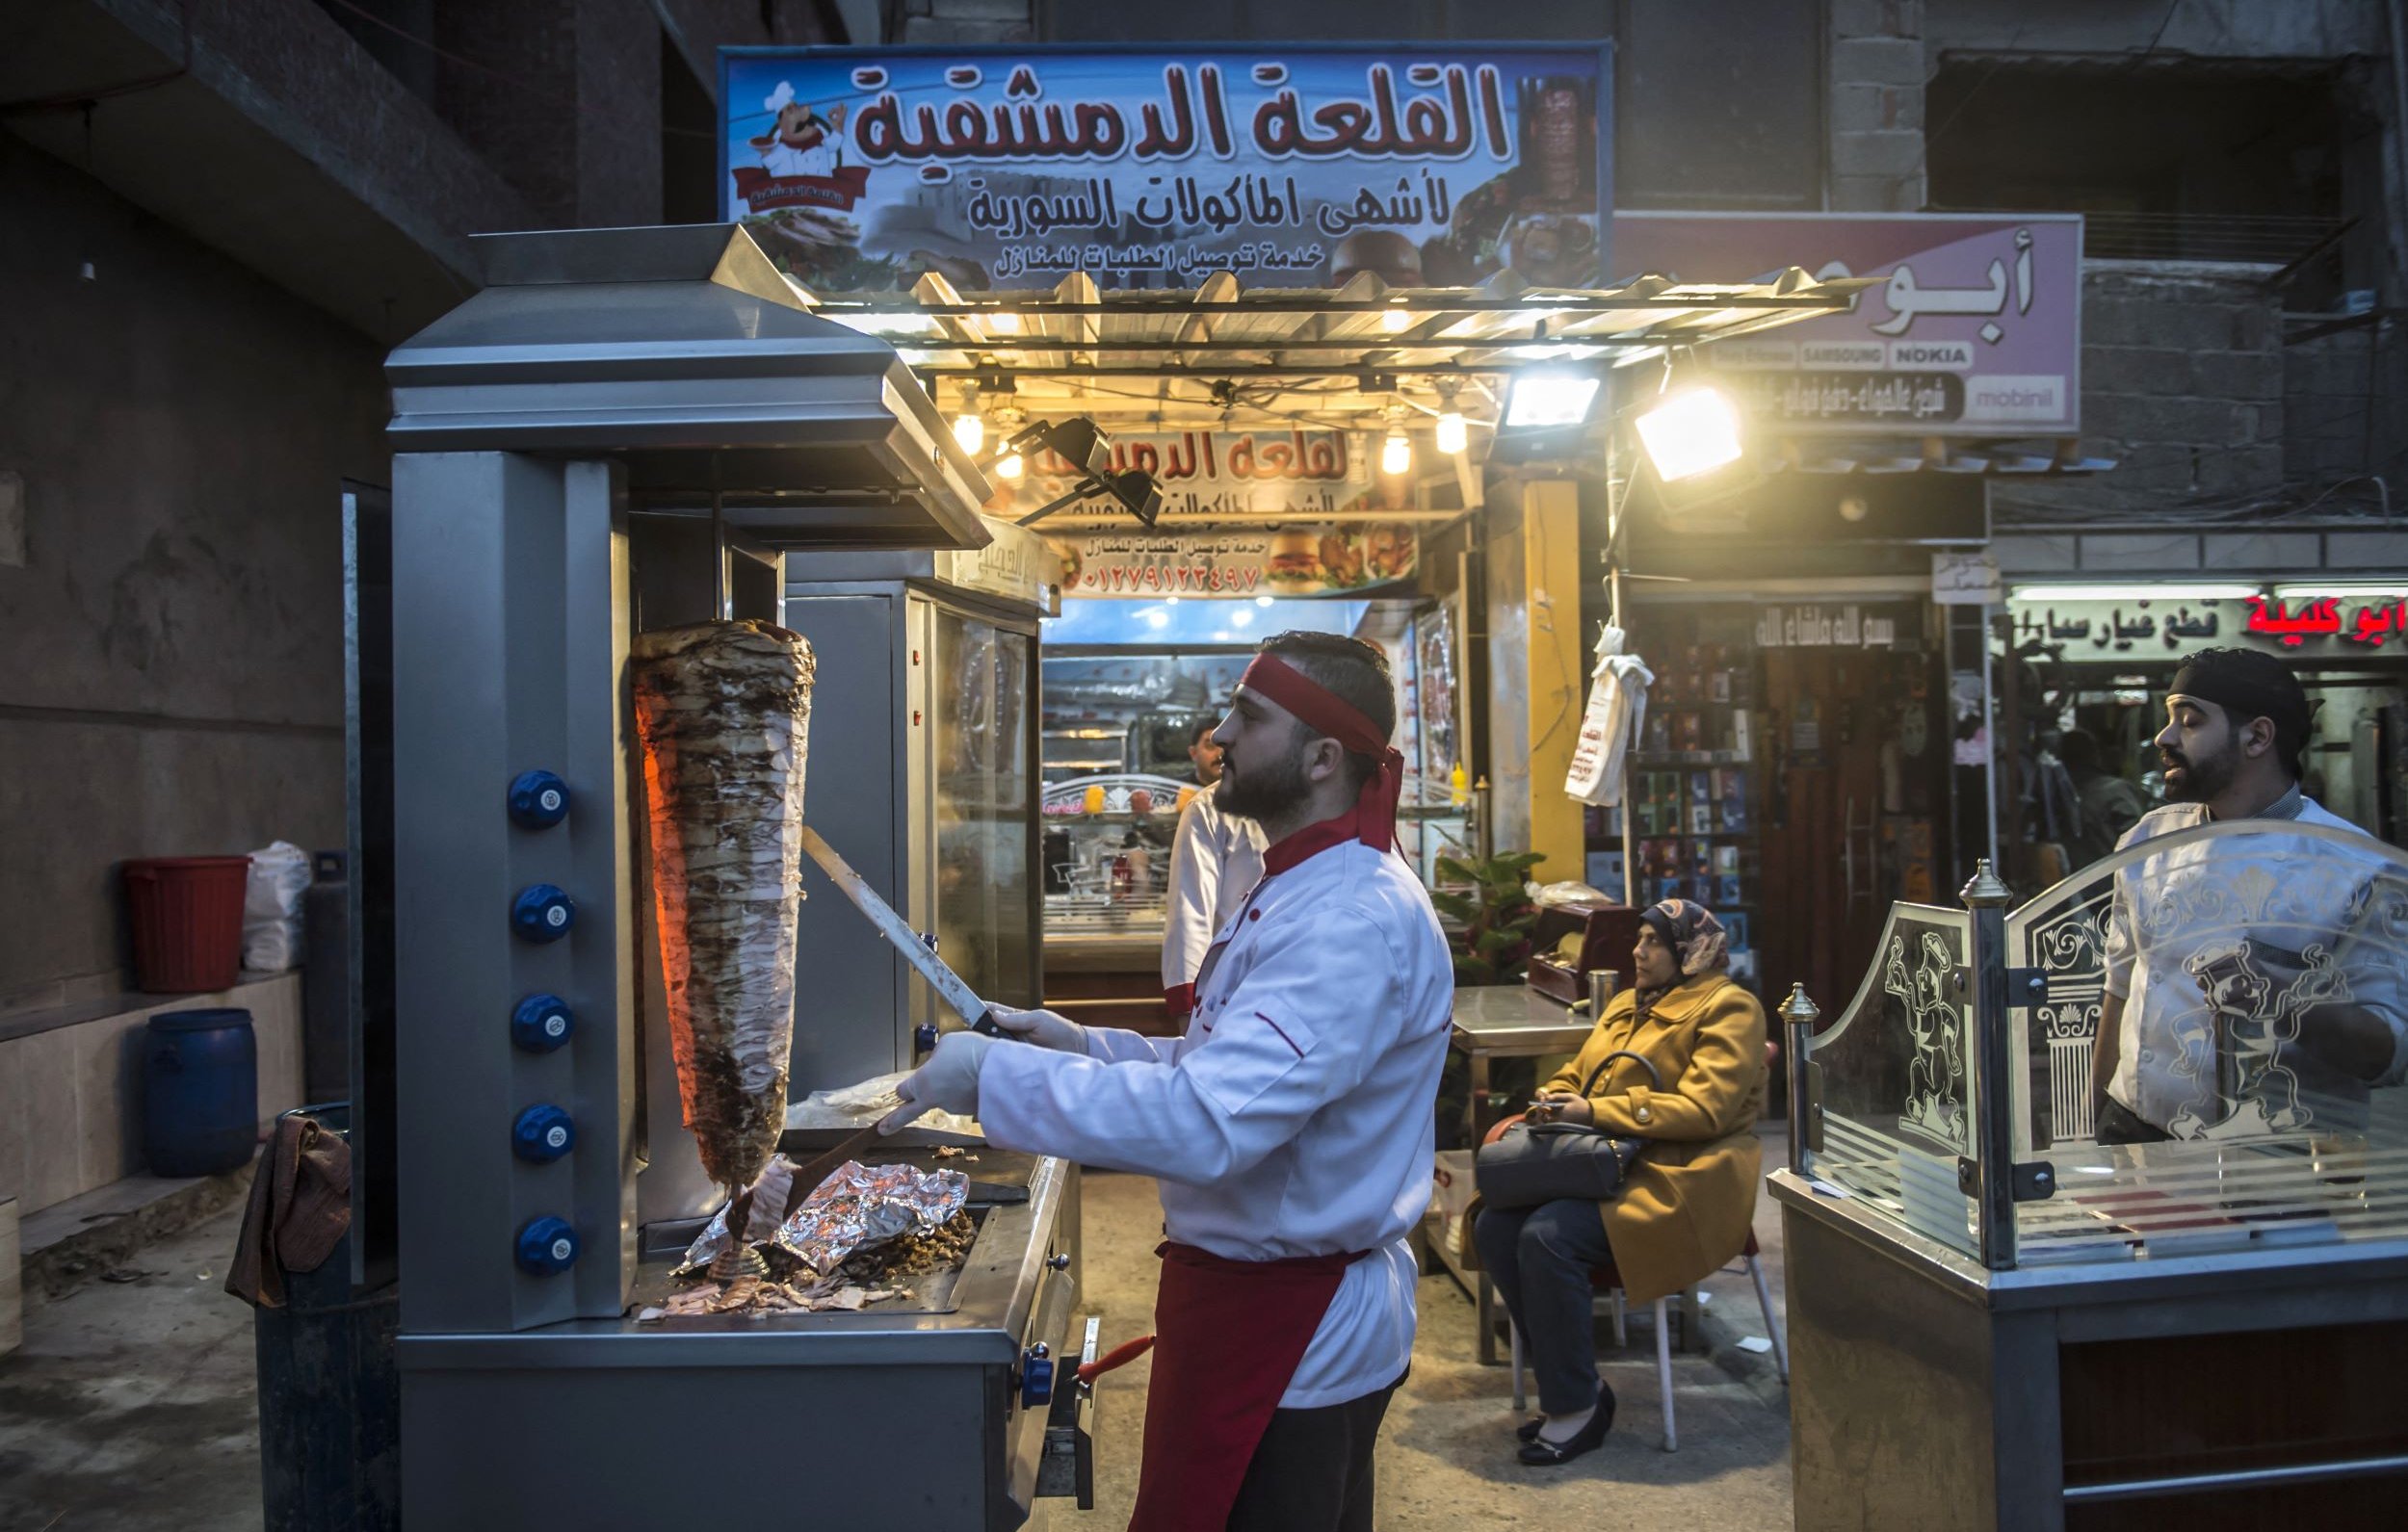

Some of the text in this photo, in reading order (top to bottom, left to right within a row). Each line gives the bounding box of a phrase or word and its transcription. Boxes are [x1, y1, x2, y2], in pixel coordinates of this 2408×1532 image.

[855, 64, 1510, 183] القلعة الدمشقية
[969, 168, 1450, 238] لأشهى المأكولات السورية
[994, 243, 1325, 278] خدمة توصيل الطلبات للمنازل
[1870, 228, 2032, 345] أبو
[1896, 348, 1967, 364] NOKIA
[1977, 389, 2054, 408] mobinil
[1086, 537, 1266, 557] خدمة توصيل الطلبات للمنازل
[2093, 600, 2156, 650] غيار
[2163, 599, 2219, 649] قطع
